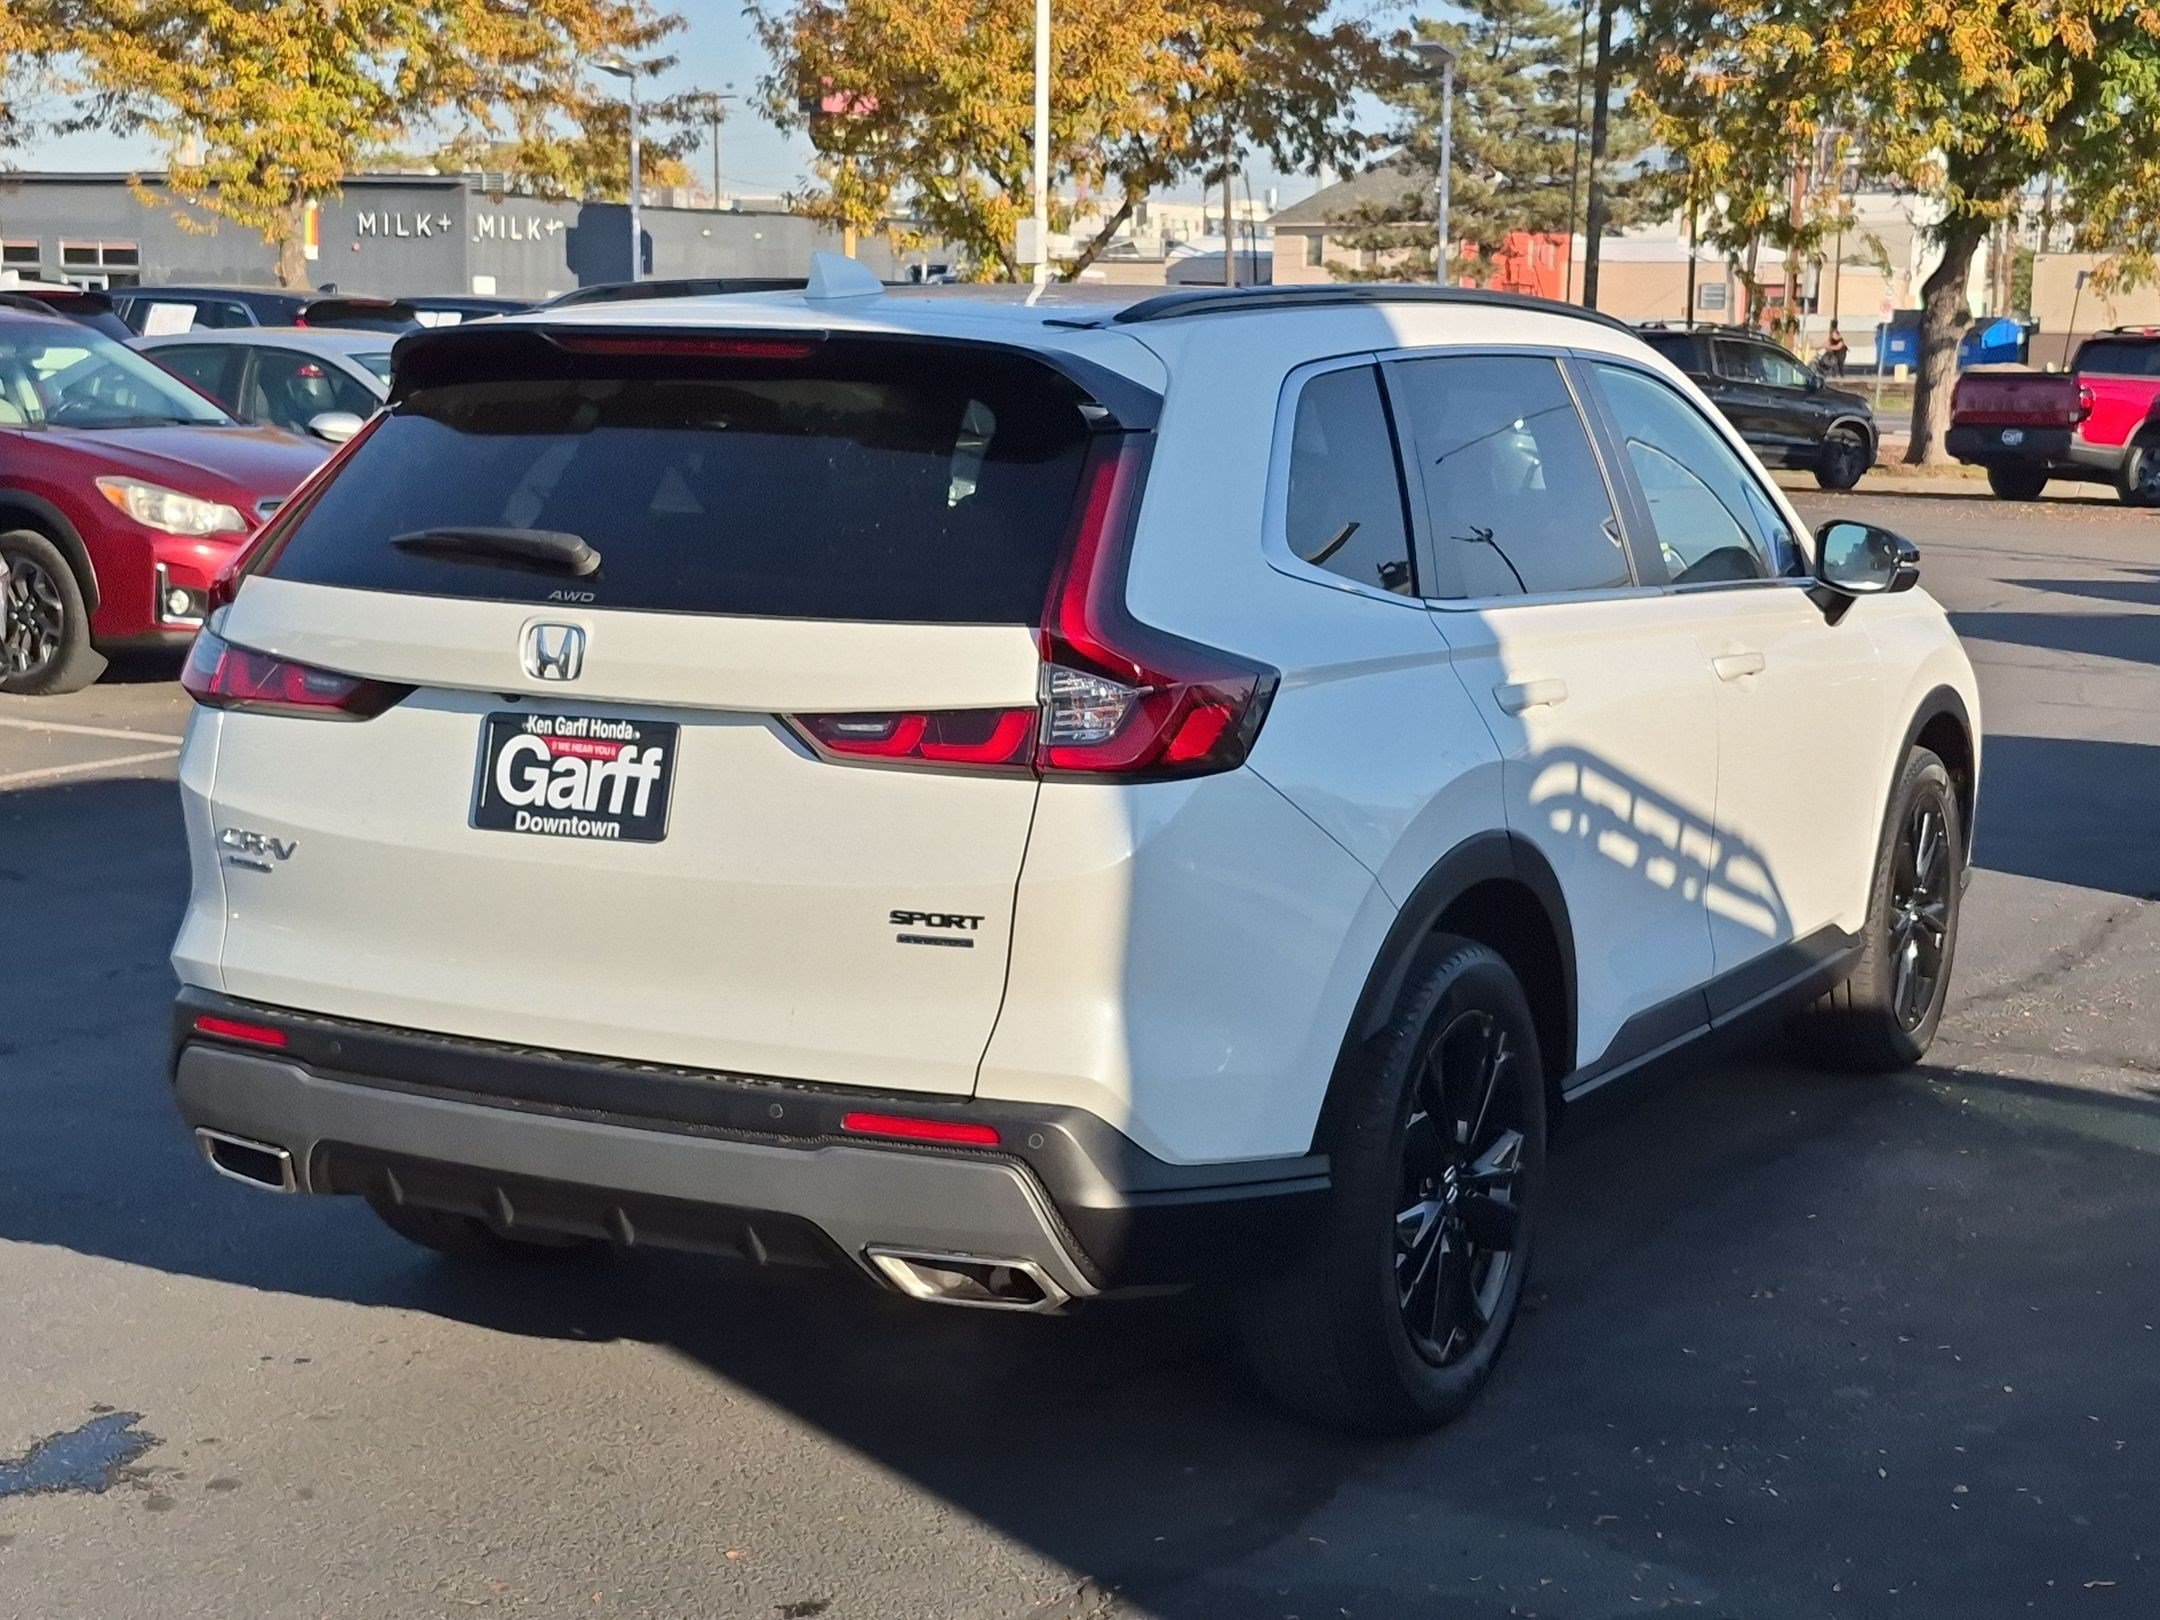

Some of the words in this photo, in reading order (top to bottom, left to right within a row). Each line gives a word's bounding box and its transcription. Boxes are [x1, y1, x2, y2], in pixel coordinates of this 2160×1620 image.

[549, 590, 595, 602] AWD
[527, 715, 552, 734] Ken
[555, 716, 589, 738] Garff
[590, 719, 633, 740] Honda
[557, 741, 571, 750] WE
[572, 742, 593, 754] HEAR
[594, 745, 611, 756] YOU
[496, 734, 663, 817] Garff
[515, 810, 620, 838] Downtown
[889, 910, 985, 930] SPORT
